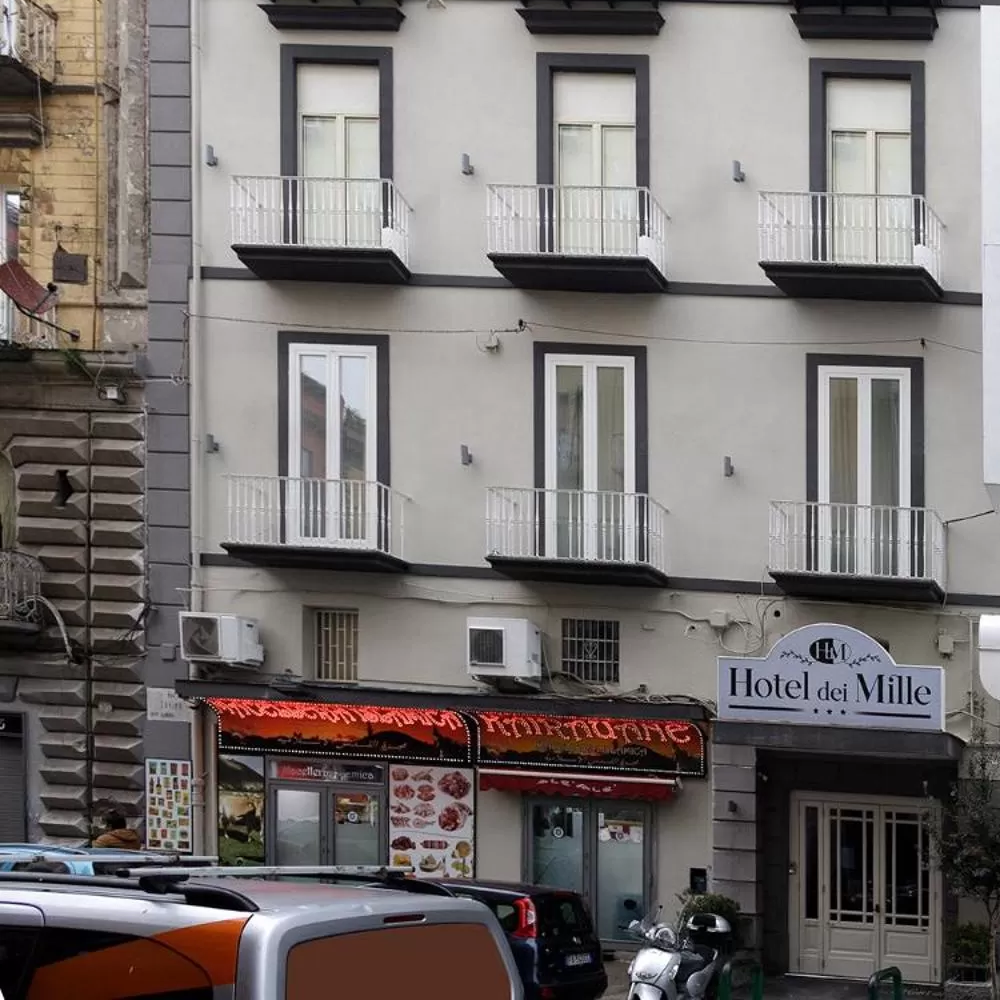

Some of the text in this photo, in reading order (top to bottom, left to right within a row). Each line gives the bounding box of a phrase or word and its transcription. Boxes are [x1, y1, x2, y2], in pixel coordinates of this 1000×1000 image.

[729, 667, 932, 706] Hotel dei Mille
